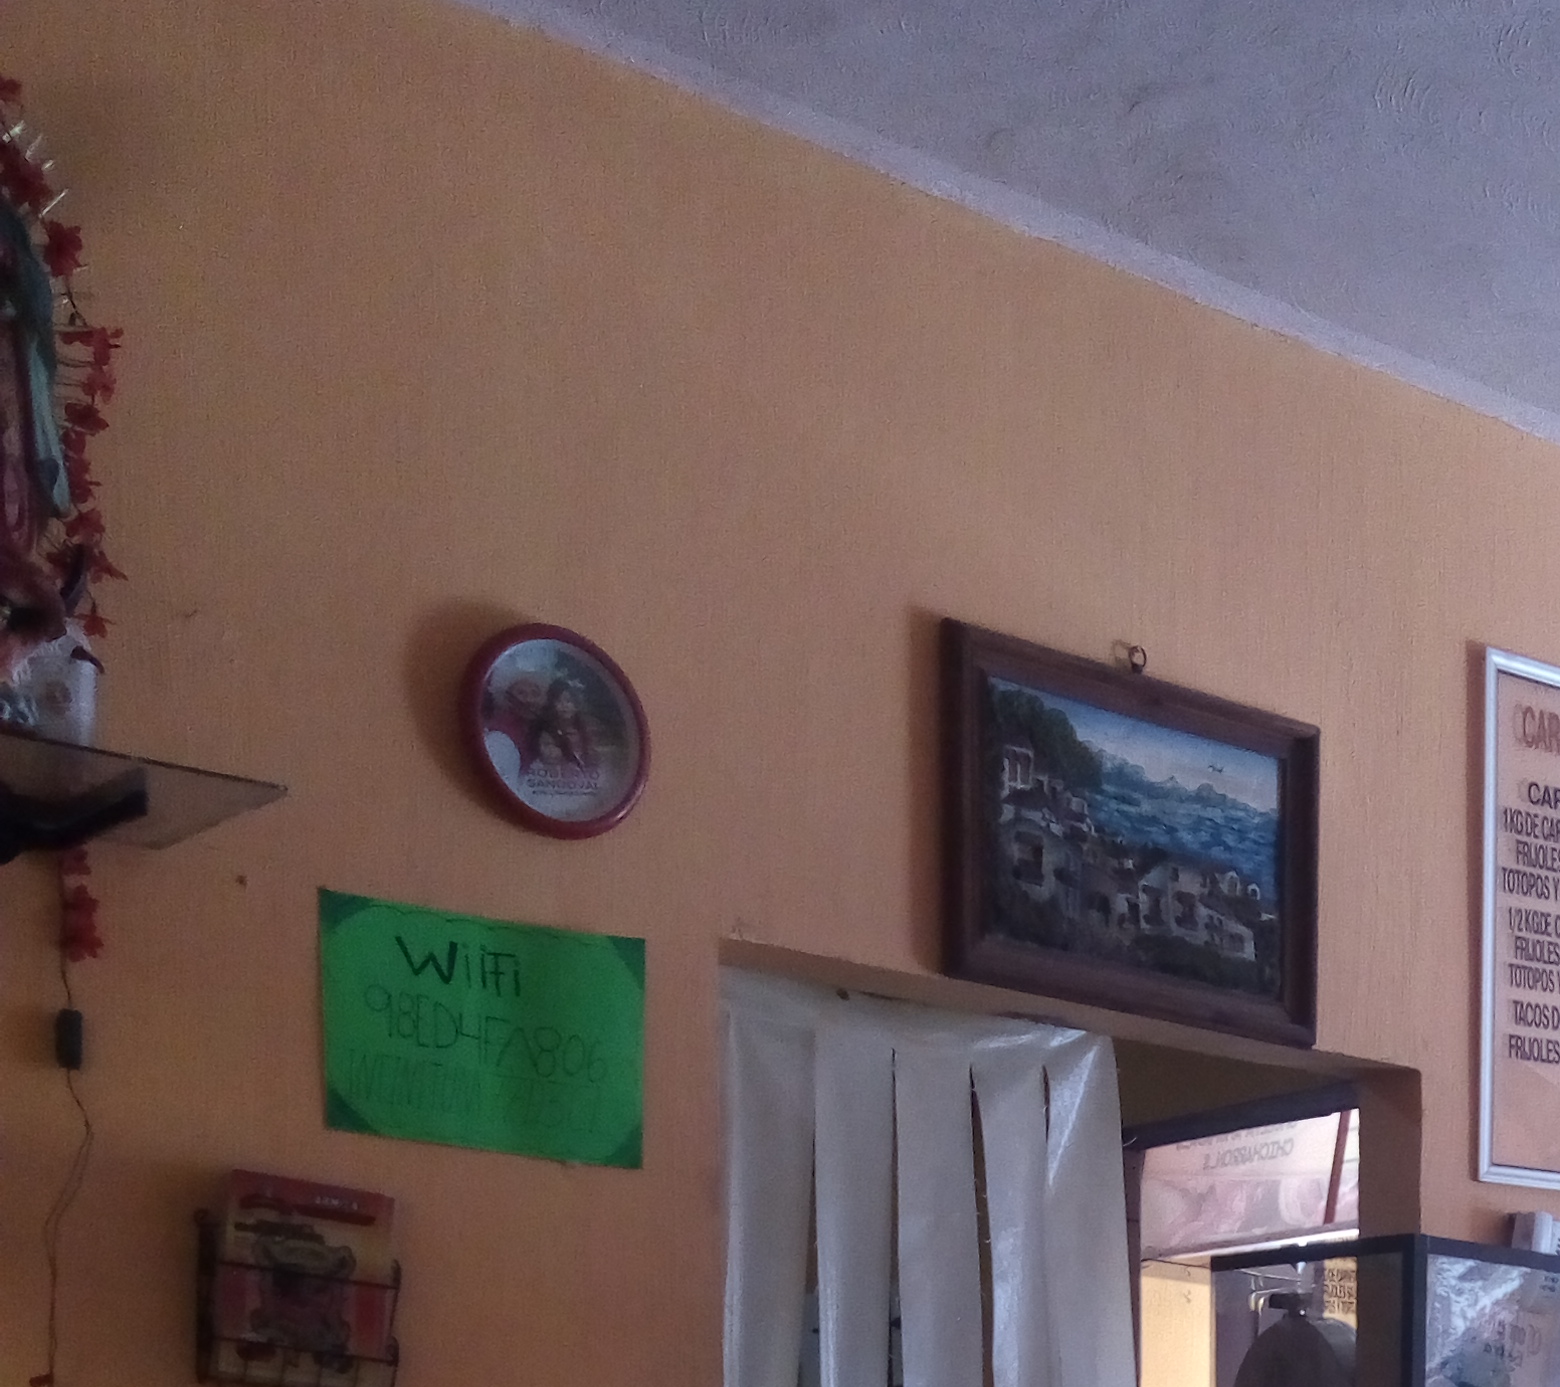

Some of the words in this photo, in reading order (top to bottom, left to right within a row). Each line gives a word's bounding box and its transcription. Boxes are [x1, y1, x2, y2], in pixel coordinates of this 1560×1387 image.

[1502, 866, 1550, 900] TOTOPOS
[1552, 876, 1560, 902] Y
[1515, 935, 1560, 966] FRIJOLES
[1508, 963, 1554, 994] TOTOPOS
[1513, 999, 1550, 1030] TACOS
[1508, 1033, 1560, 1064] FRIJOLES
